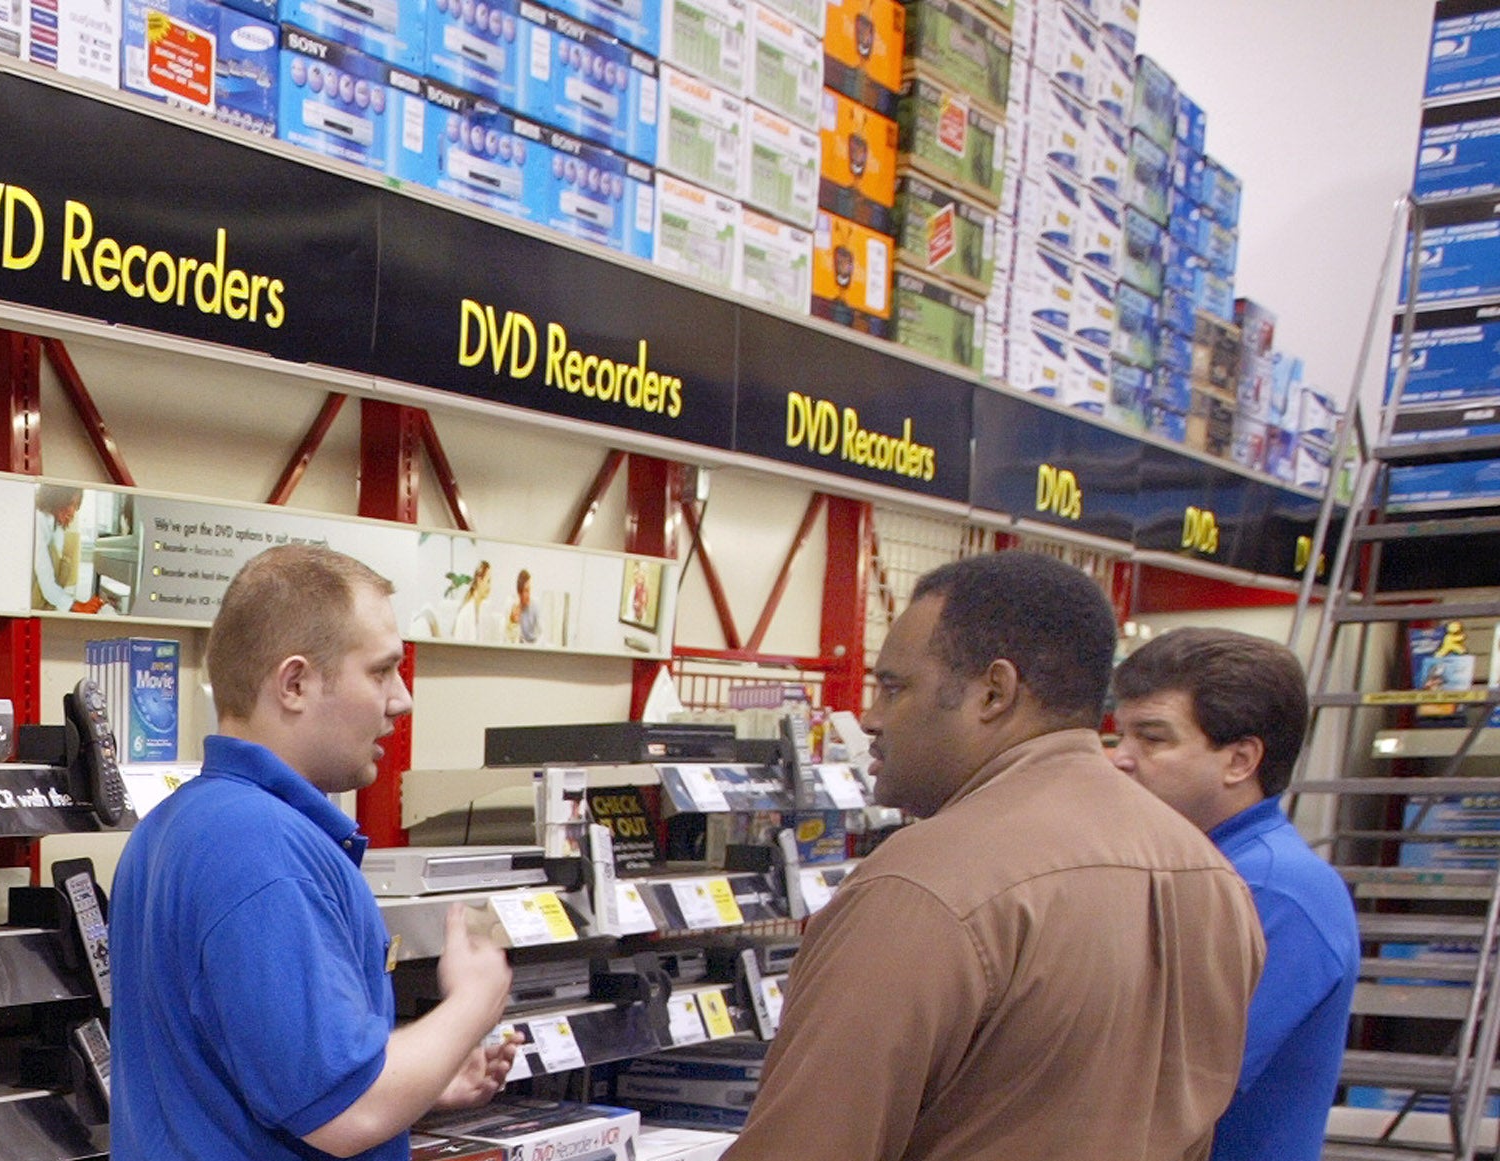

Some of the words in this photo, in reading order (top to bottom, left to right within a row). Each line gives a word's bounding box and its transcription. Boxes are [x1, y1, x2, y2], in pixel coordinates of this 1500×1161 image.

[288, 33, 328, 58] SONY
[61, 200, 286, 329] Recorders
[458, 298, 538, 379] DVD
[545, 321, 683, 418] Recorders
[786, 391, 839, 456] DVD
[841, 406, 936, 483] Recorders
[1035, 463, 1082, 521] DVDs
[215, 525, 233, 538] DVD
[135, 669, 175, 690] Movie
[16, 788, 48, 808] with
[592, 795, 643, 815] CHECK
[616, 818, 649, 837] OUT
[556, 1135, 593, 1158] Recorder
[601, 1126, 621, 1147] VCR
